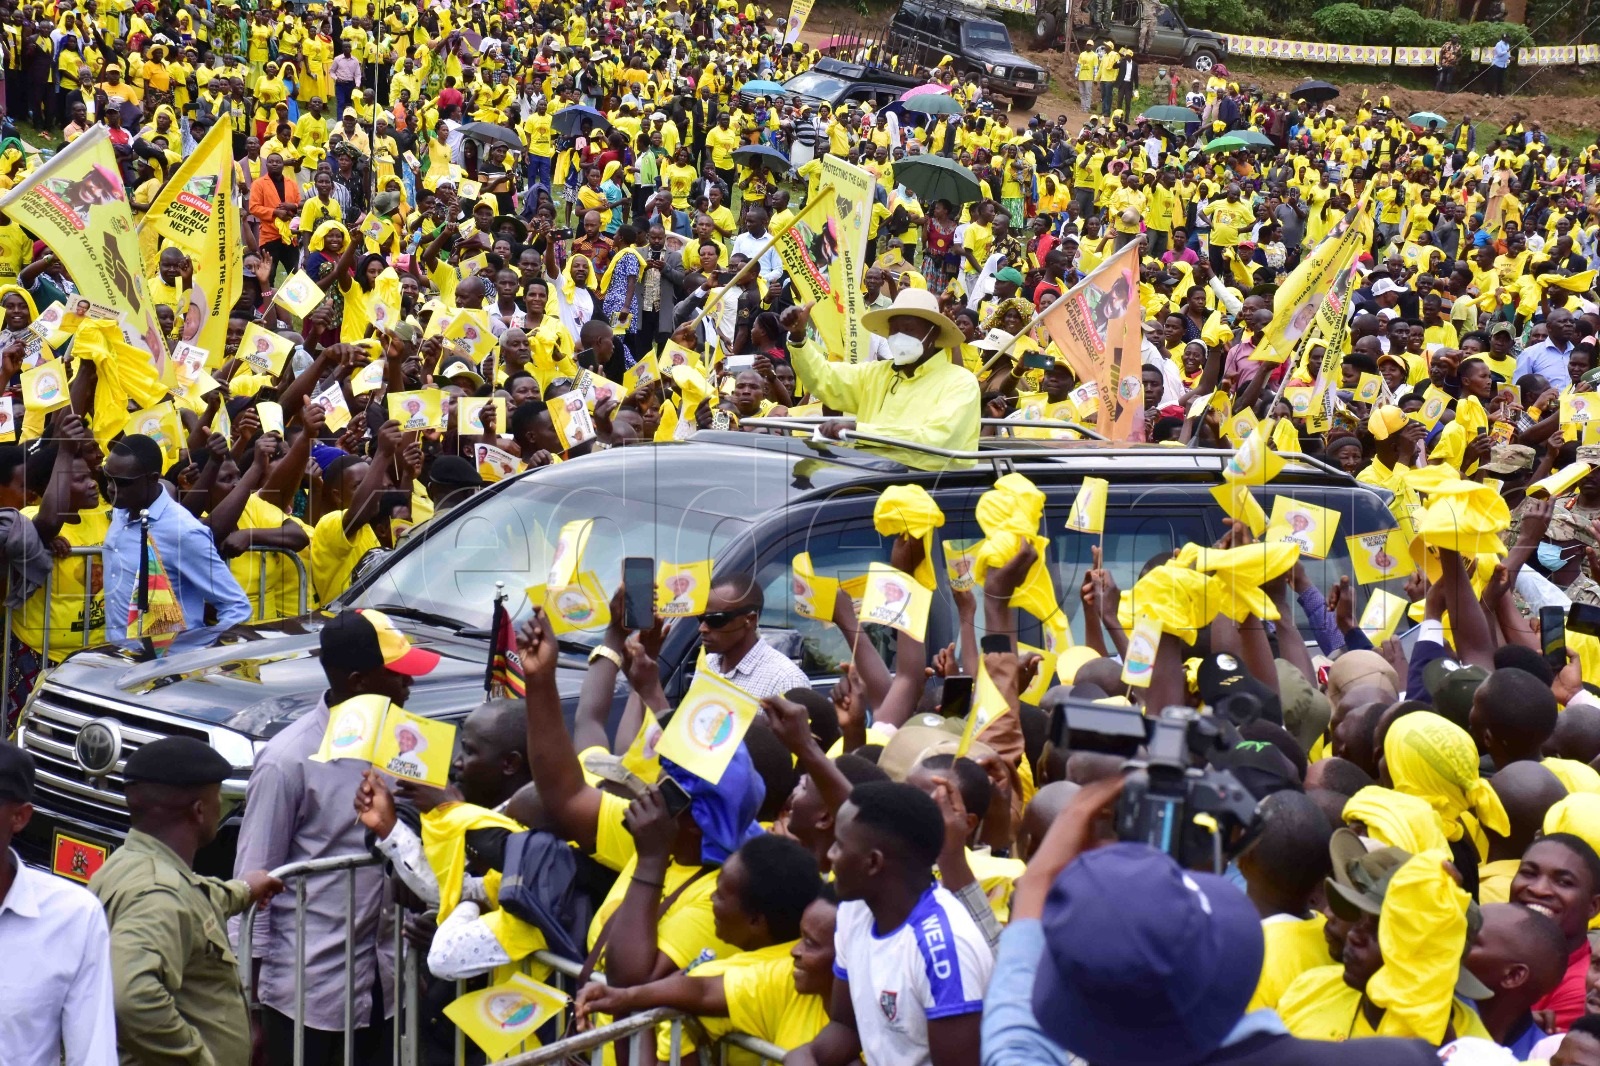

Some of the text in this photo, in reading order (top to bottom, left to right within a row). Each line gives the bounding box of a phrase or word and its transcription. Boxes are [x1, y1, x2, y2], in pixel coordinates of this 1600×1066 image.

[21, 202, 45, 219] NEXT
[36, 186, 82, 228] CHAIRMAN PLU
[43, 200, 79, 235] MUHOOZI
[170, 201, 188, 214] GEN.
[169, 220, 195, 236] NEXT
[217, 193, 226, 263] PROTECTING
[79, 233, 97, 261] Tuko
[96, 262, 117, 306] Pamoja
[782, 249, 800, 275] NEXT
[792, 229, 830, 291] CHAIRMAN PLU
[212, 287, 224, 316] GAINS
[1066, 319, 1079, 342] NEXT
[1071, 298, 1100, 362] GEN. MUHOOZI
[1078, 295, 1095, 334] CHAIRMAN
[1093, 335, 1103, 350] PLU
[1323, 349, 1334, 373] GAINS
[386, 764, 421, 778] MUSEVENI
[391, 758, 418, 771] YOWERI
[920, 914, 951, 980] WELD
